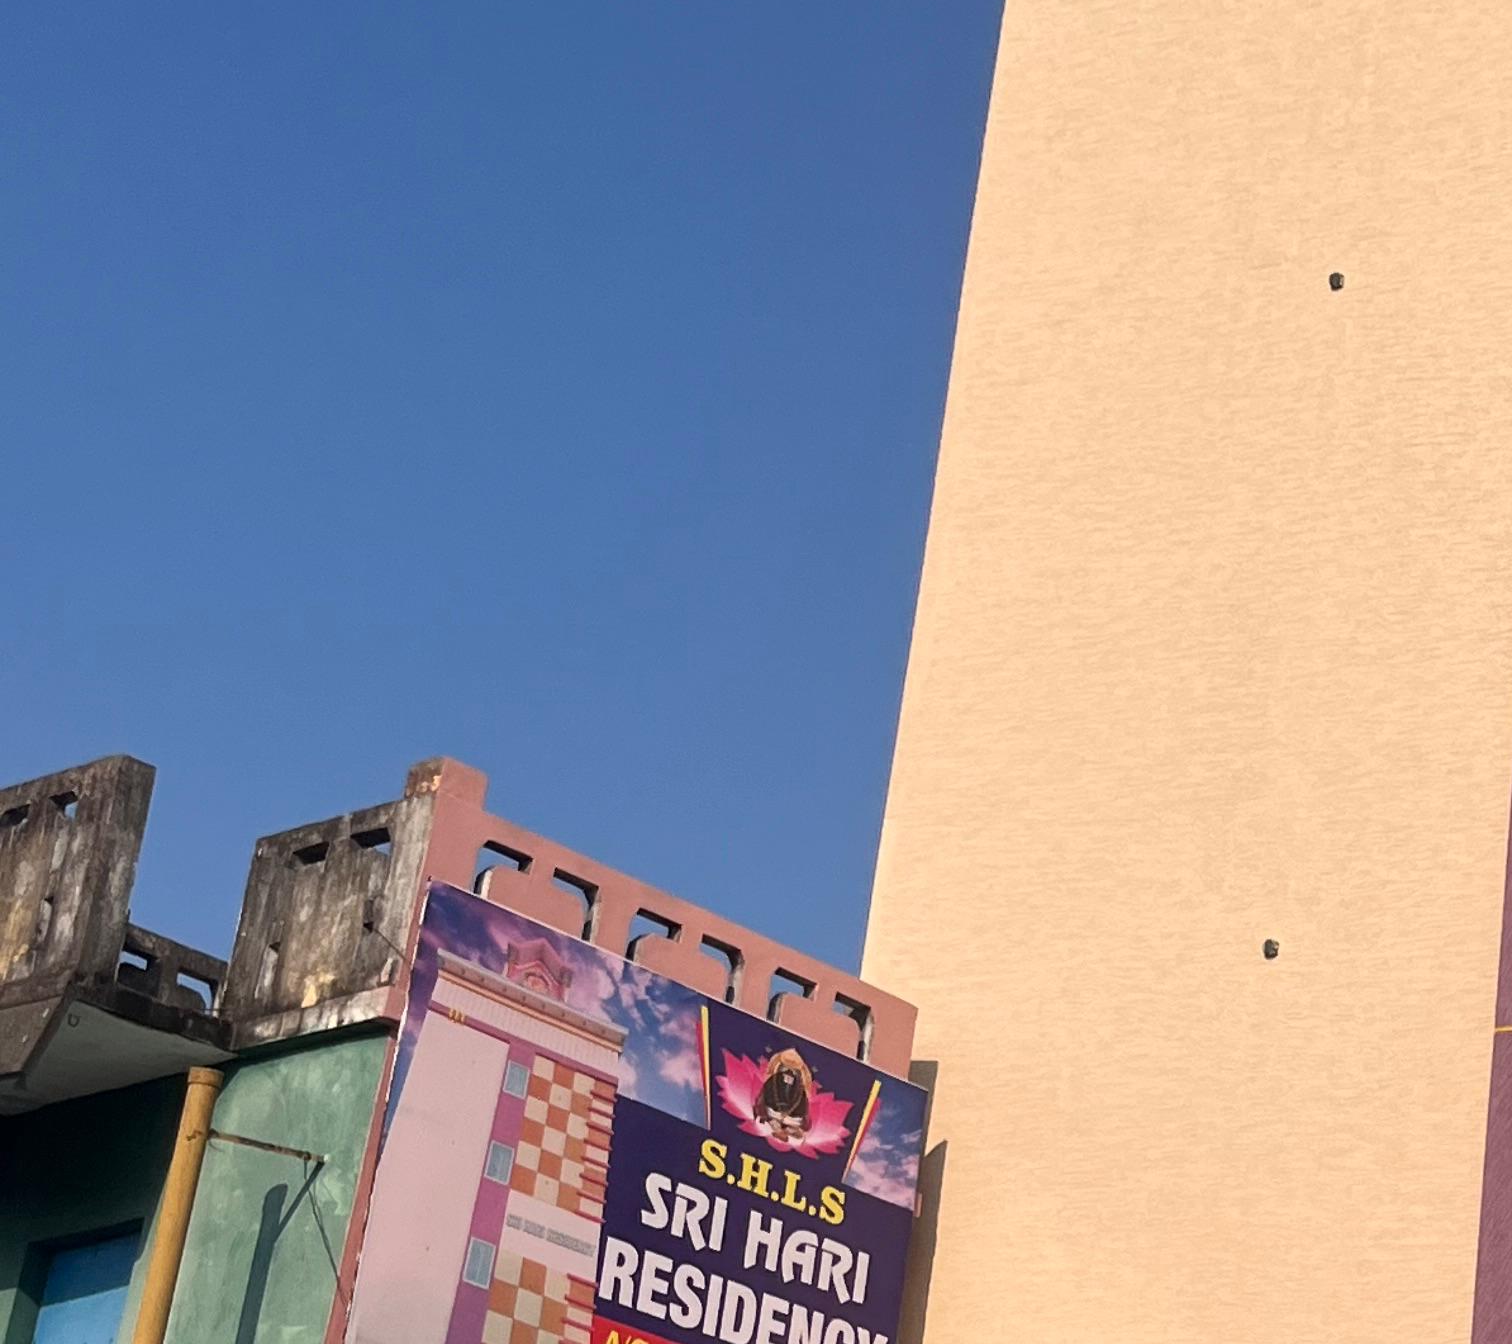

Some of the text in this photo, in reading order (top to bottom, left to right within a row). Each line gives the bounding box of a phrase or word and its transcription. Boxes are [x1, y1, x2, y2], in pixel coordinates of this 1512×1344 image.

[698, 1138, 846, 1226] S.H.L.S
[640, 1172, 728, 1252] SRI
[743, 1209, 871, 1305] HARI
